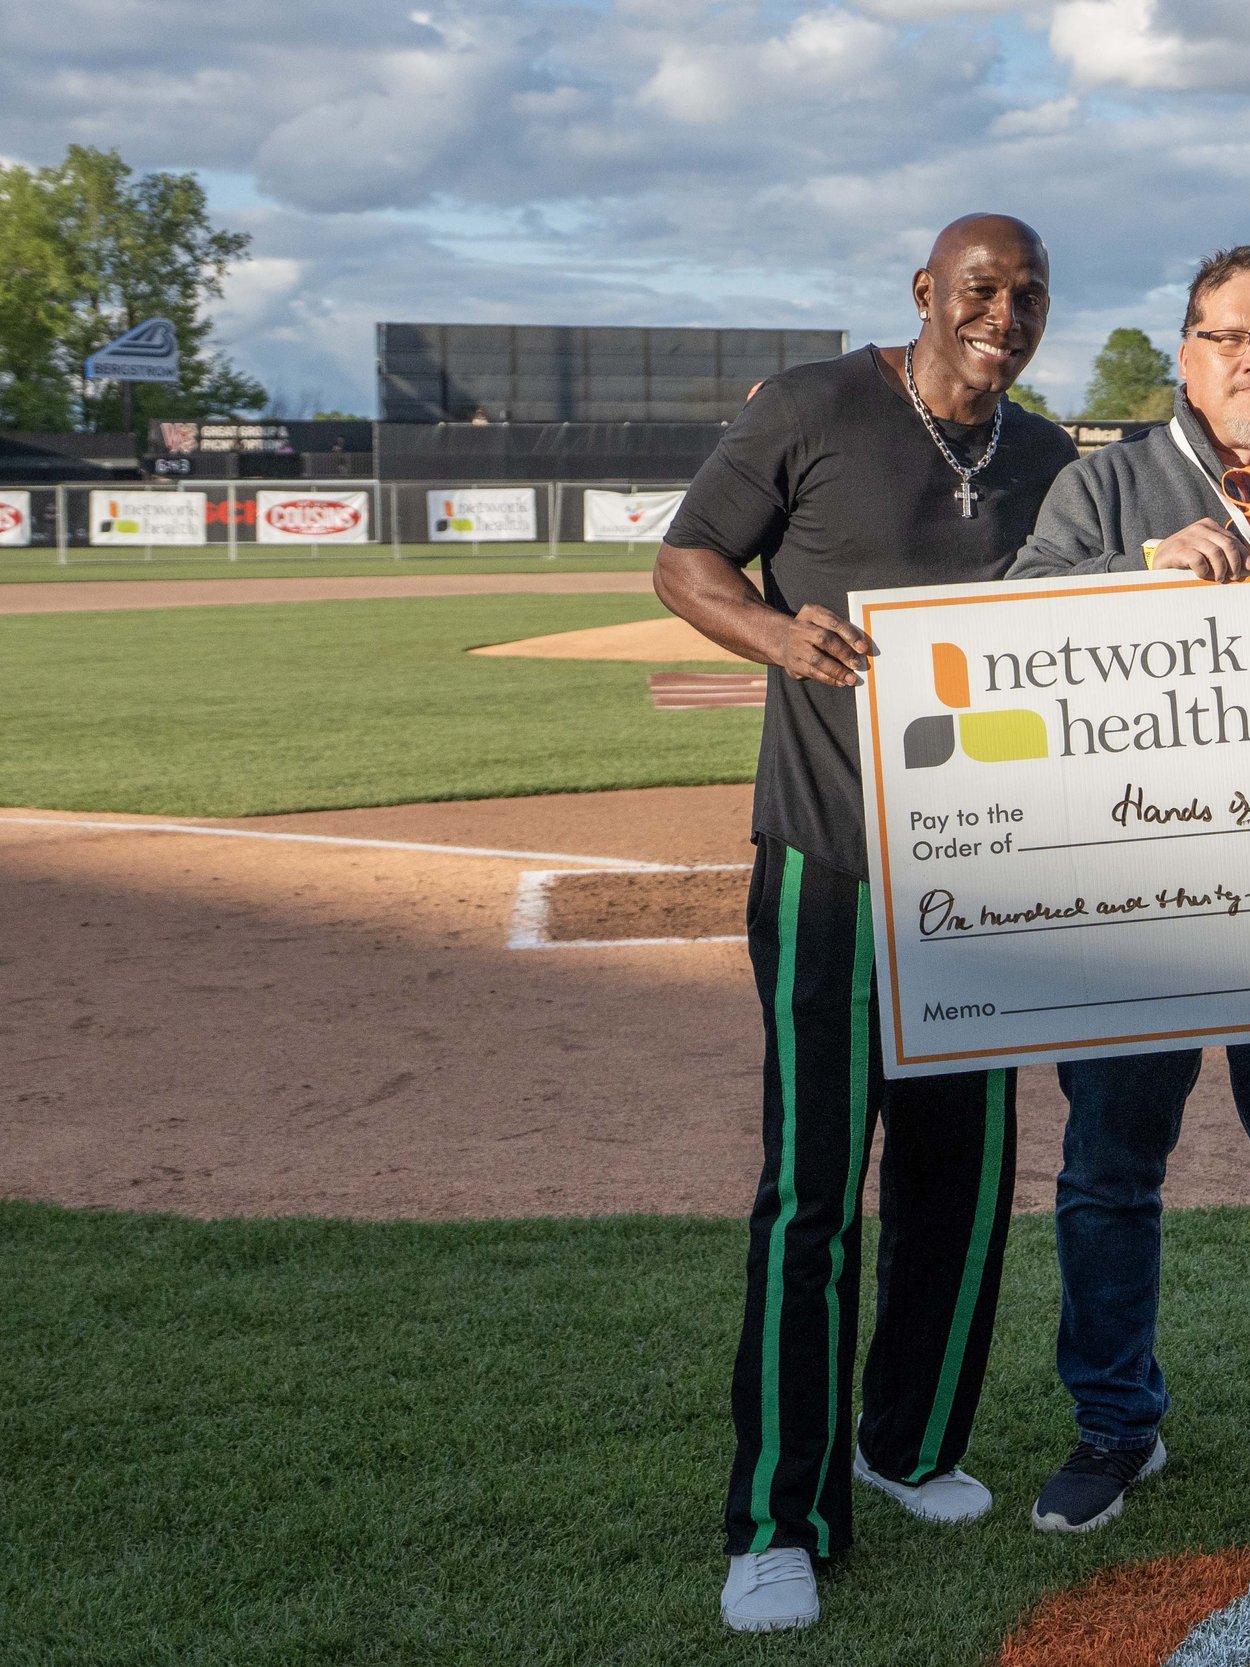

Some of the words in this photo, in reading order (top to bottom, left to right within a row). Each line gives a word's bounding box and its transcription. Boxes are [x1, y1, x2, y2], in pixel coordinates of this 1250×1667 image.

[122, 499, 199, 516] network
[459, 497, 529, 513] network
[143, 517, 199, 534] health
[476, 514, 530, 531] health
[982, 615, 1248, 692] network
[909, 810, 949, 834] Pay
[957, 808, 981, 826] to
[987, 804, 1025, 824] the
[912, 838, 982, 861] Order
[990, 835, 1014, 856] of
[1111, 783, 1213, 827] Hands
[919, 888, 974, 937] One
[980, 898, 1088, 925] hundred
[1097, 897, 1151, 914] and
[922, 1001, 996, 1023] Memo
